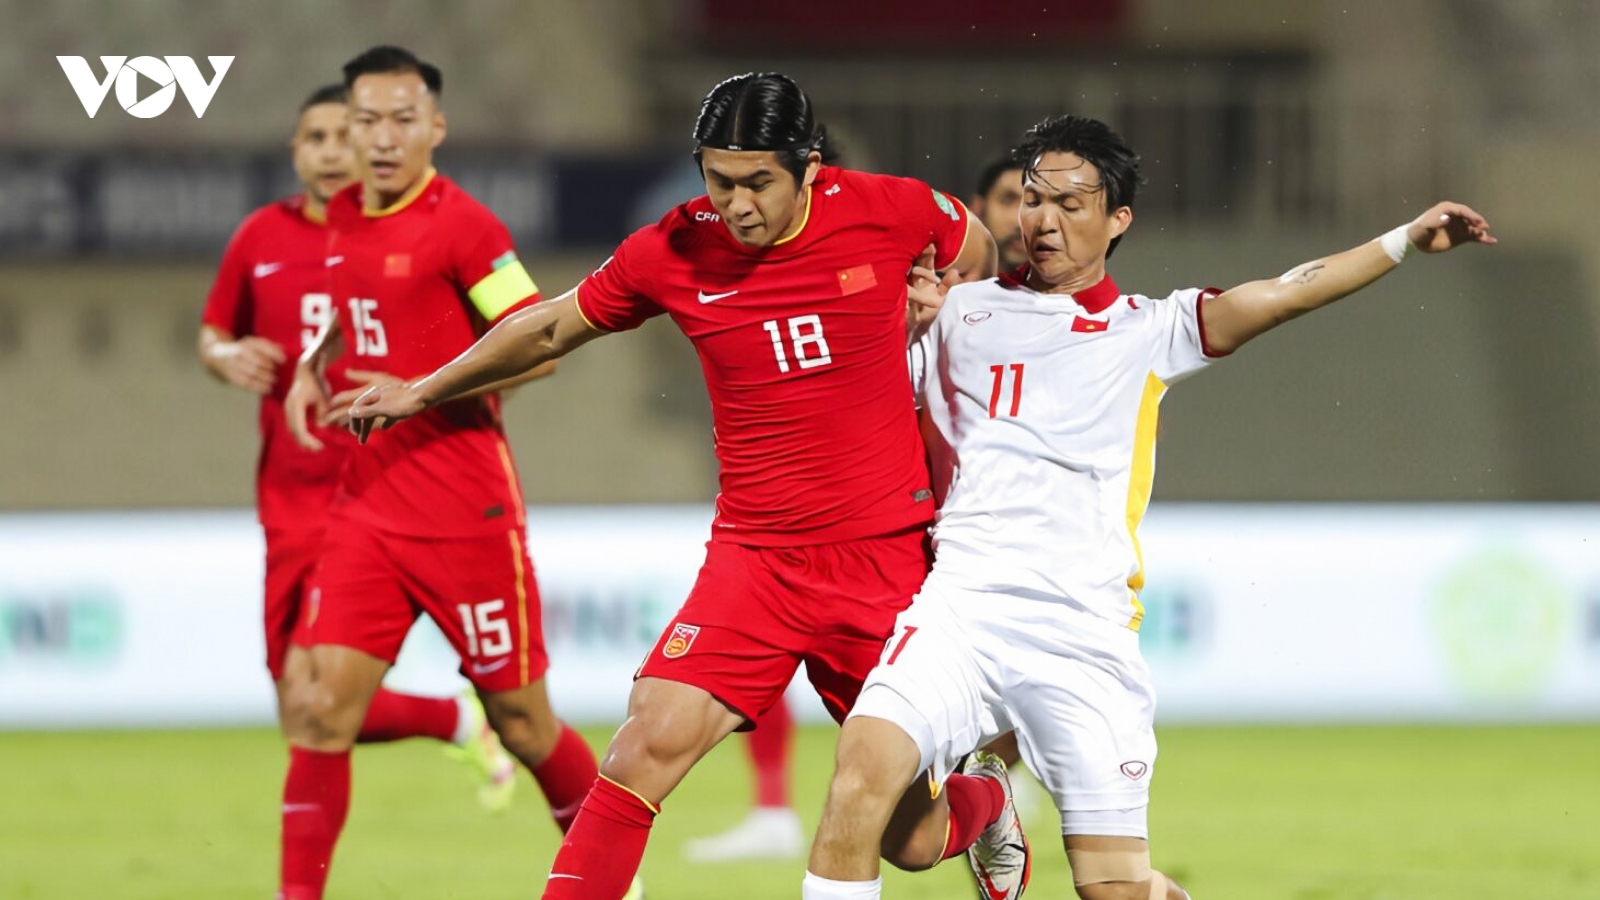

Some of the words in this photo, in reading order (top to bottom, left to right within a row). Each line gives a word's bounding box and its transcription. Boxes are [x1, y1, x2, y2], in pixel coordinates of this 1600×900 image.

[347, 298, 389, 357] 15
[763, 314, 832, 373] 18
[989, 363, 1024, 418] 11
[456, 599, 513, 657] 15
